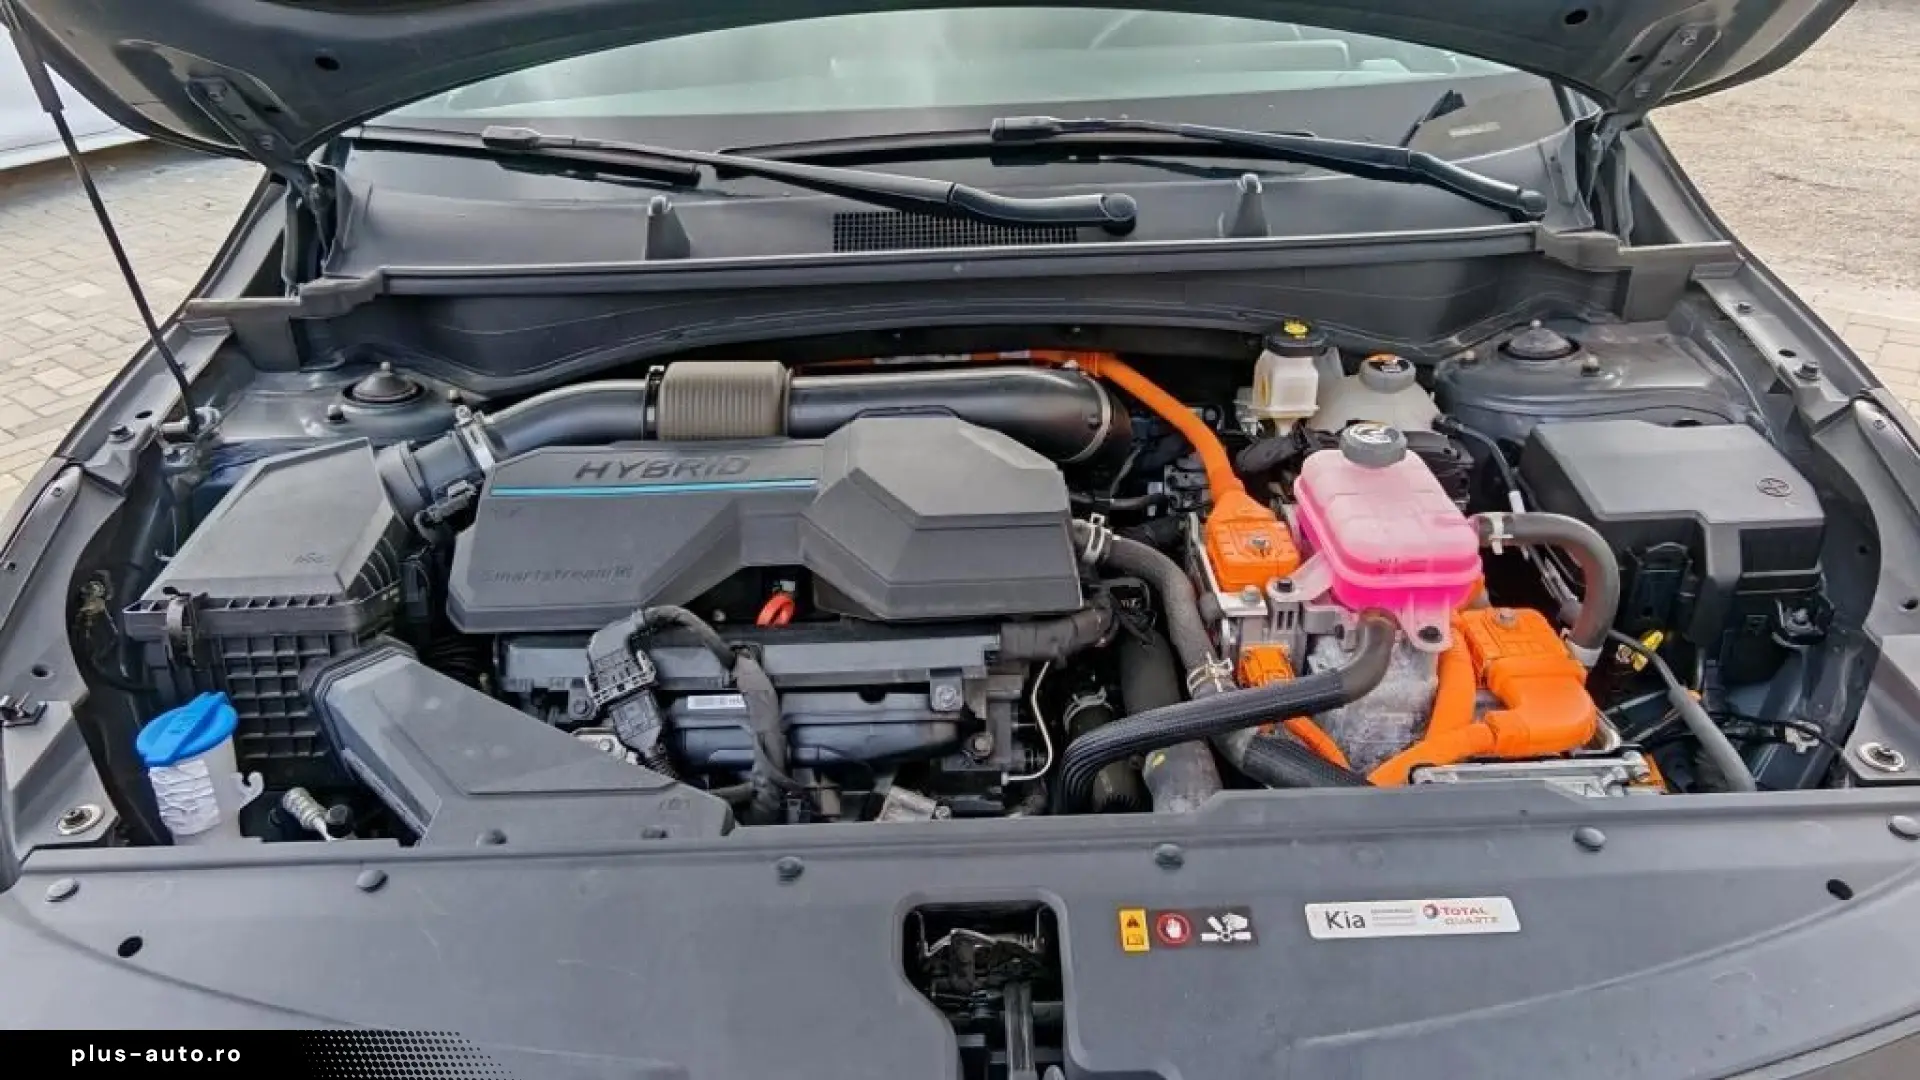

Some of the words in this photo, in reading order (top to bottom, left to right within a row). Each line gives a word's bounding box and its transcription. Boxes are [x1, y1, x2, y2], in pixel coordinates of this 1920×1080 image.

[574, 456, 751, 480] HYBRID
[1325, 910, 1366, 930] Kia
[1440, 906, 1488, 917] TOTAL
